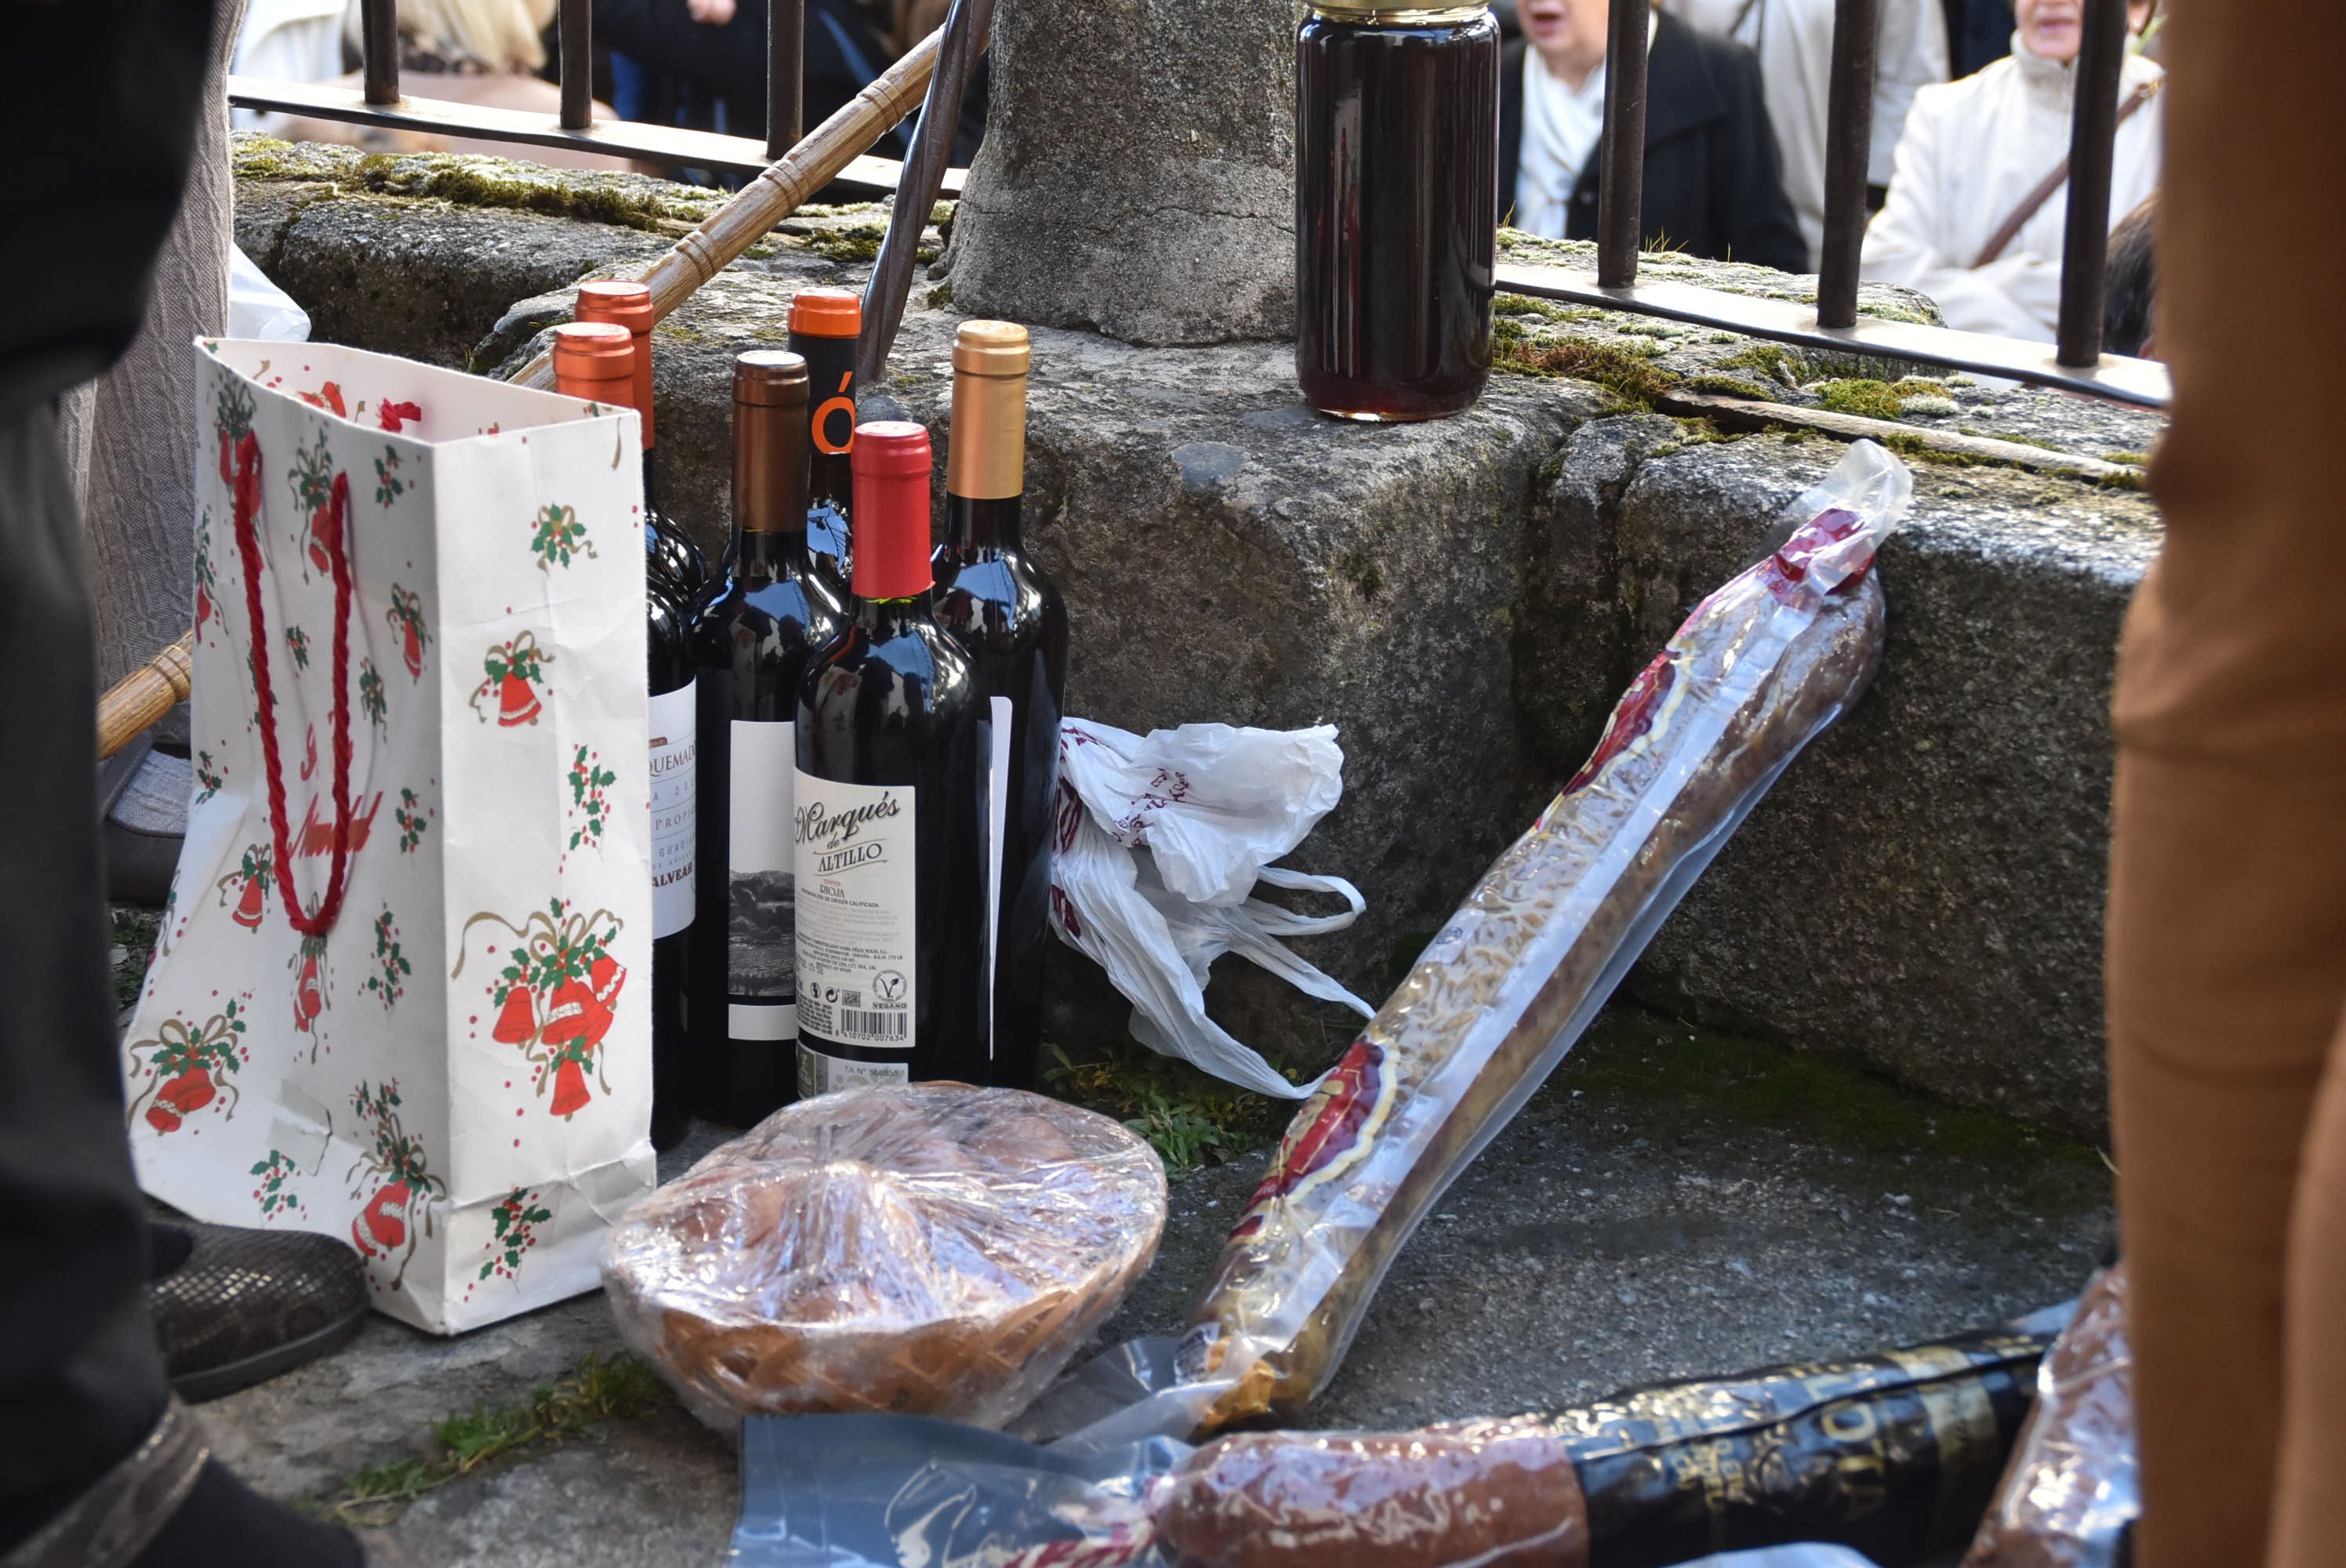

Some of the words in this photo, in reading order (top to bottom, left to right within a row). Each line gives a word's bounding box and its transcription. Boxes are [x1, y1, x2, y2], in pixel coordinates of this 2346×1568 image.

[795, 790, 900, 845] Marqués
[826, 832, 840, 850] de
[818, 843, 882, 873] ALTILLO
[820, 884, 846, 898] RIOJA
